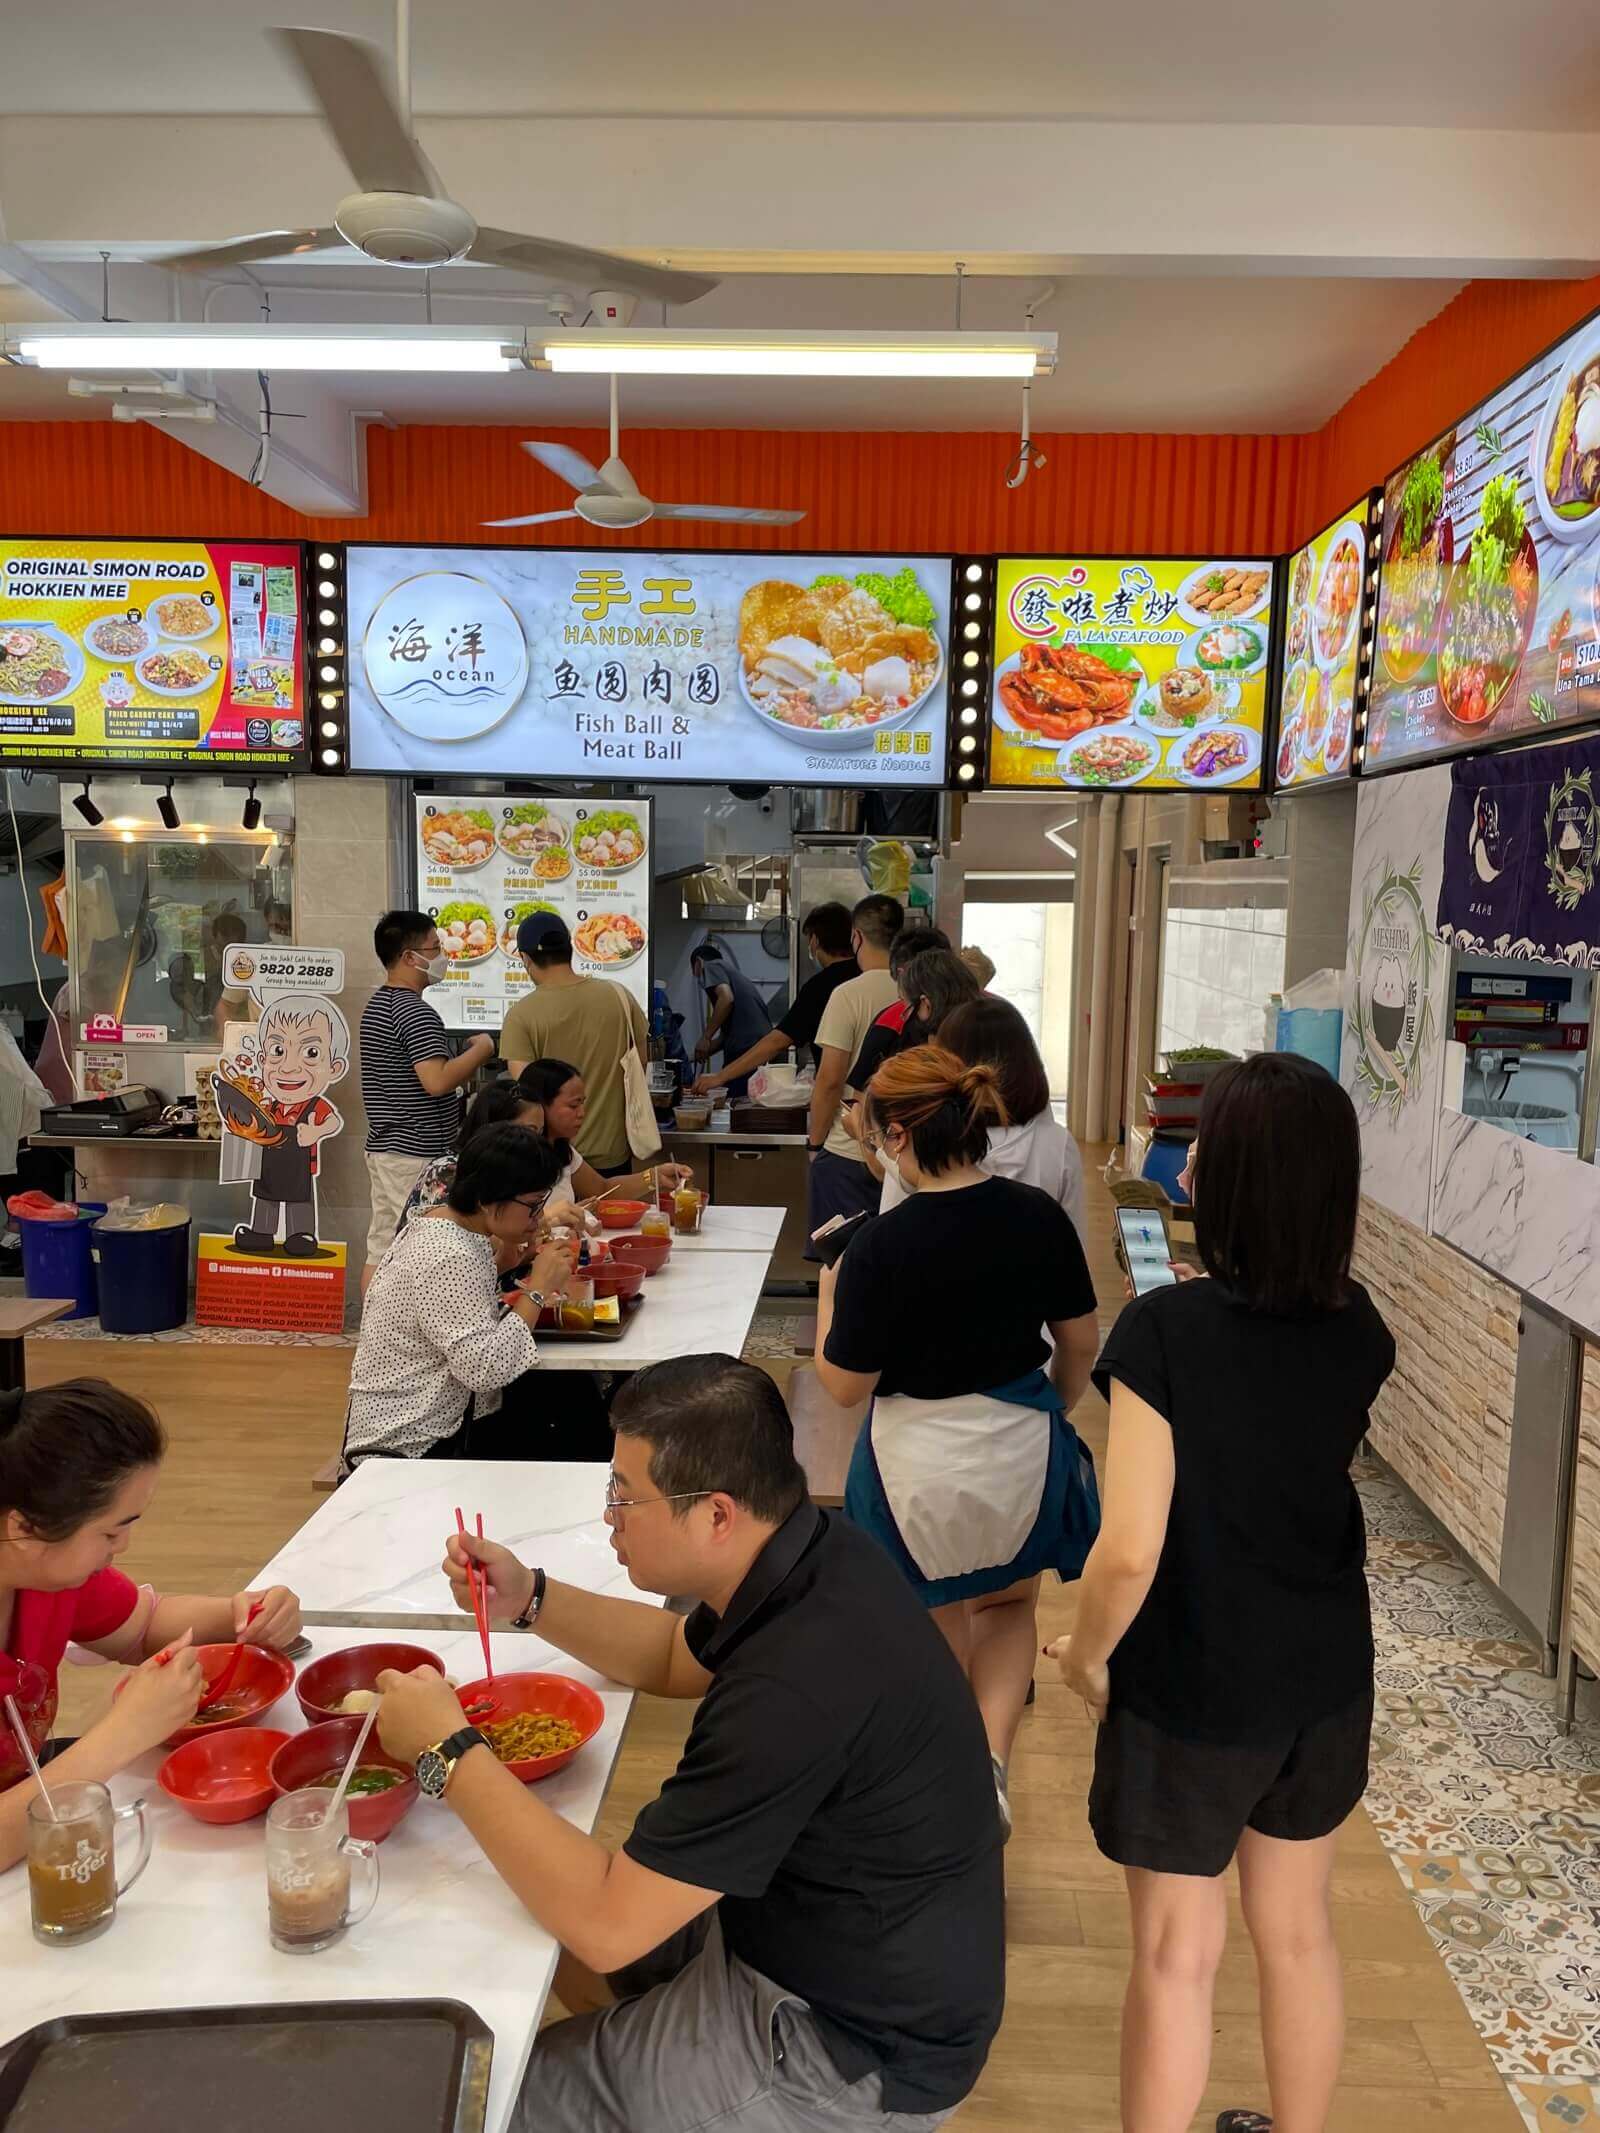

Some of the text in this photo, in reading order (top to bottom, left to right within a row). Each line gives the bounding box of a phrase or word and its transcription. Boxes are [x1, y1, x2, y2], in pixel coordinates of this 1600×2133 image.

[7, 561, 205, 578] ORIGINAL SIMON ROAD
[8, 582, 127, 598] HOKKIEN MEE
[571, 569, 697, 621] 手工
[1020, 588, 1178, 626] 發啦煮炒
[387, 618, 486, 670] 海洋
[563, 625, 704, 647] HANDMADE
[1064, 630, 1185, 643] FA LA SEAFOOD
[432, 669, 495, 682] ocean
[547, 658, 720, 706] 鱼圆肉圆
[575, 713, 690, 735] Fish Ball &
[584, 739, 681, 760] Meat Ball
[806, 756, 931, 771] SIGNATURE NOODLE
[1371, 927, 1410, 951] MESHIYA
[259, 963, 335, 977] 9820 2888
[56, 1851, 108, 1884] Tiger
